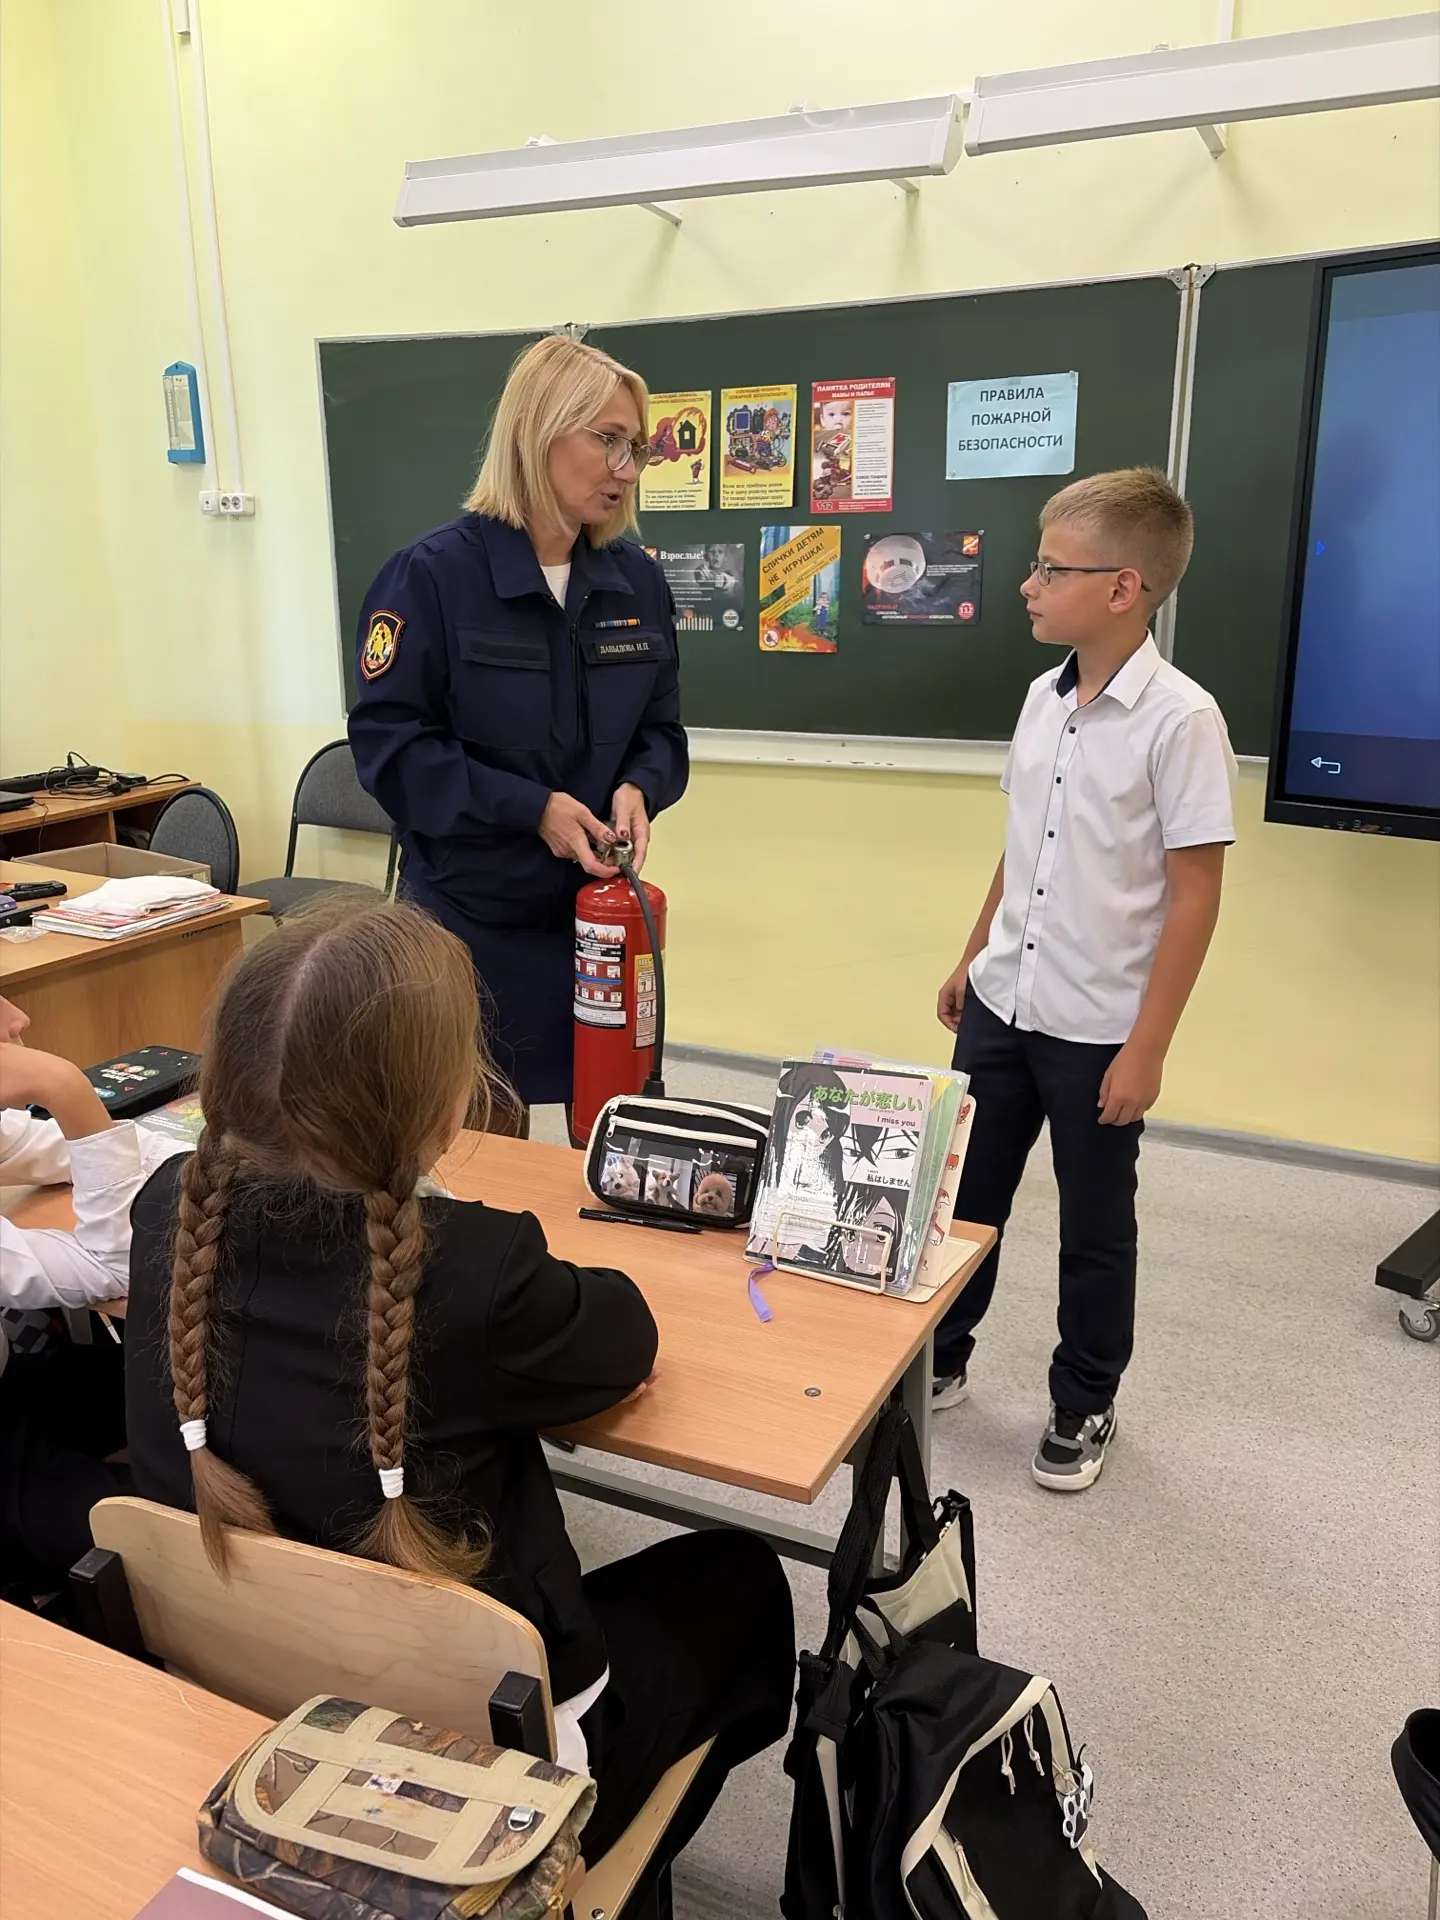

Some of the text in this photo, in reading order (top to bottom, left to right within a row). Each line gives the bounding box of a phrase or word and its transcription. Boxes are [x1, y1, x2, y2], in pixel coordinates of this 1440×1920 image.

[817, 382, 891, 392] ПАМЯТКА РОДИТЕЛЯМ
[980, 387, 1044, 402] ПРАВИЛА
[971, 407, 1051, 426] ПОЖАРНОЙ
[958, 435, 1063, 451] БЕЗОПАСНОСТИ
[817, 502, 833, 510] 112
[660, 550, 705, 562] Взрослые!
[762, 547, 795, 574] СПИЧКИ
[796, 527, 825, 552] ДЕТЯМ
[768, 573, 780, 585] НЕ
[782, 542, 825, 575] ИГРУШКА!
[600, 644, 636, 654] ДАВЫДОВА
[813, 1085, 923, 1111] あなたが恋しい
[881, 1117, 899, 1125] miss
[866, 1173, 911, 1188] 私はしません
